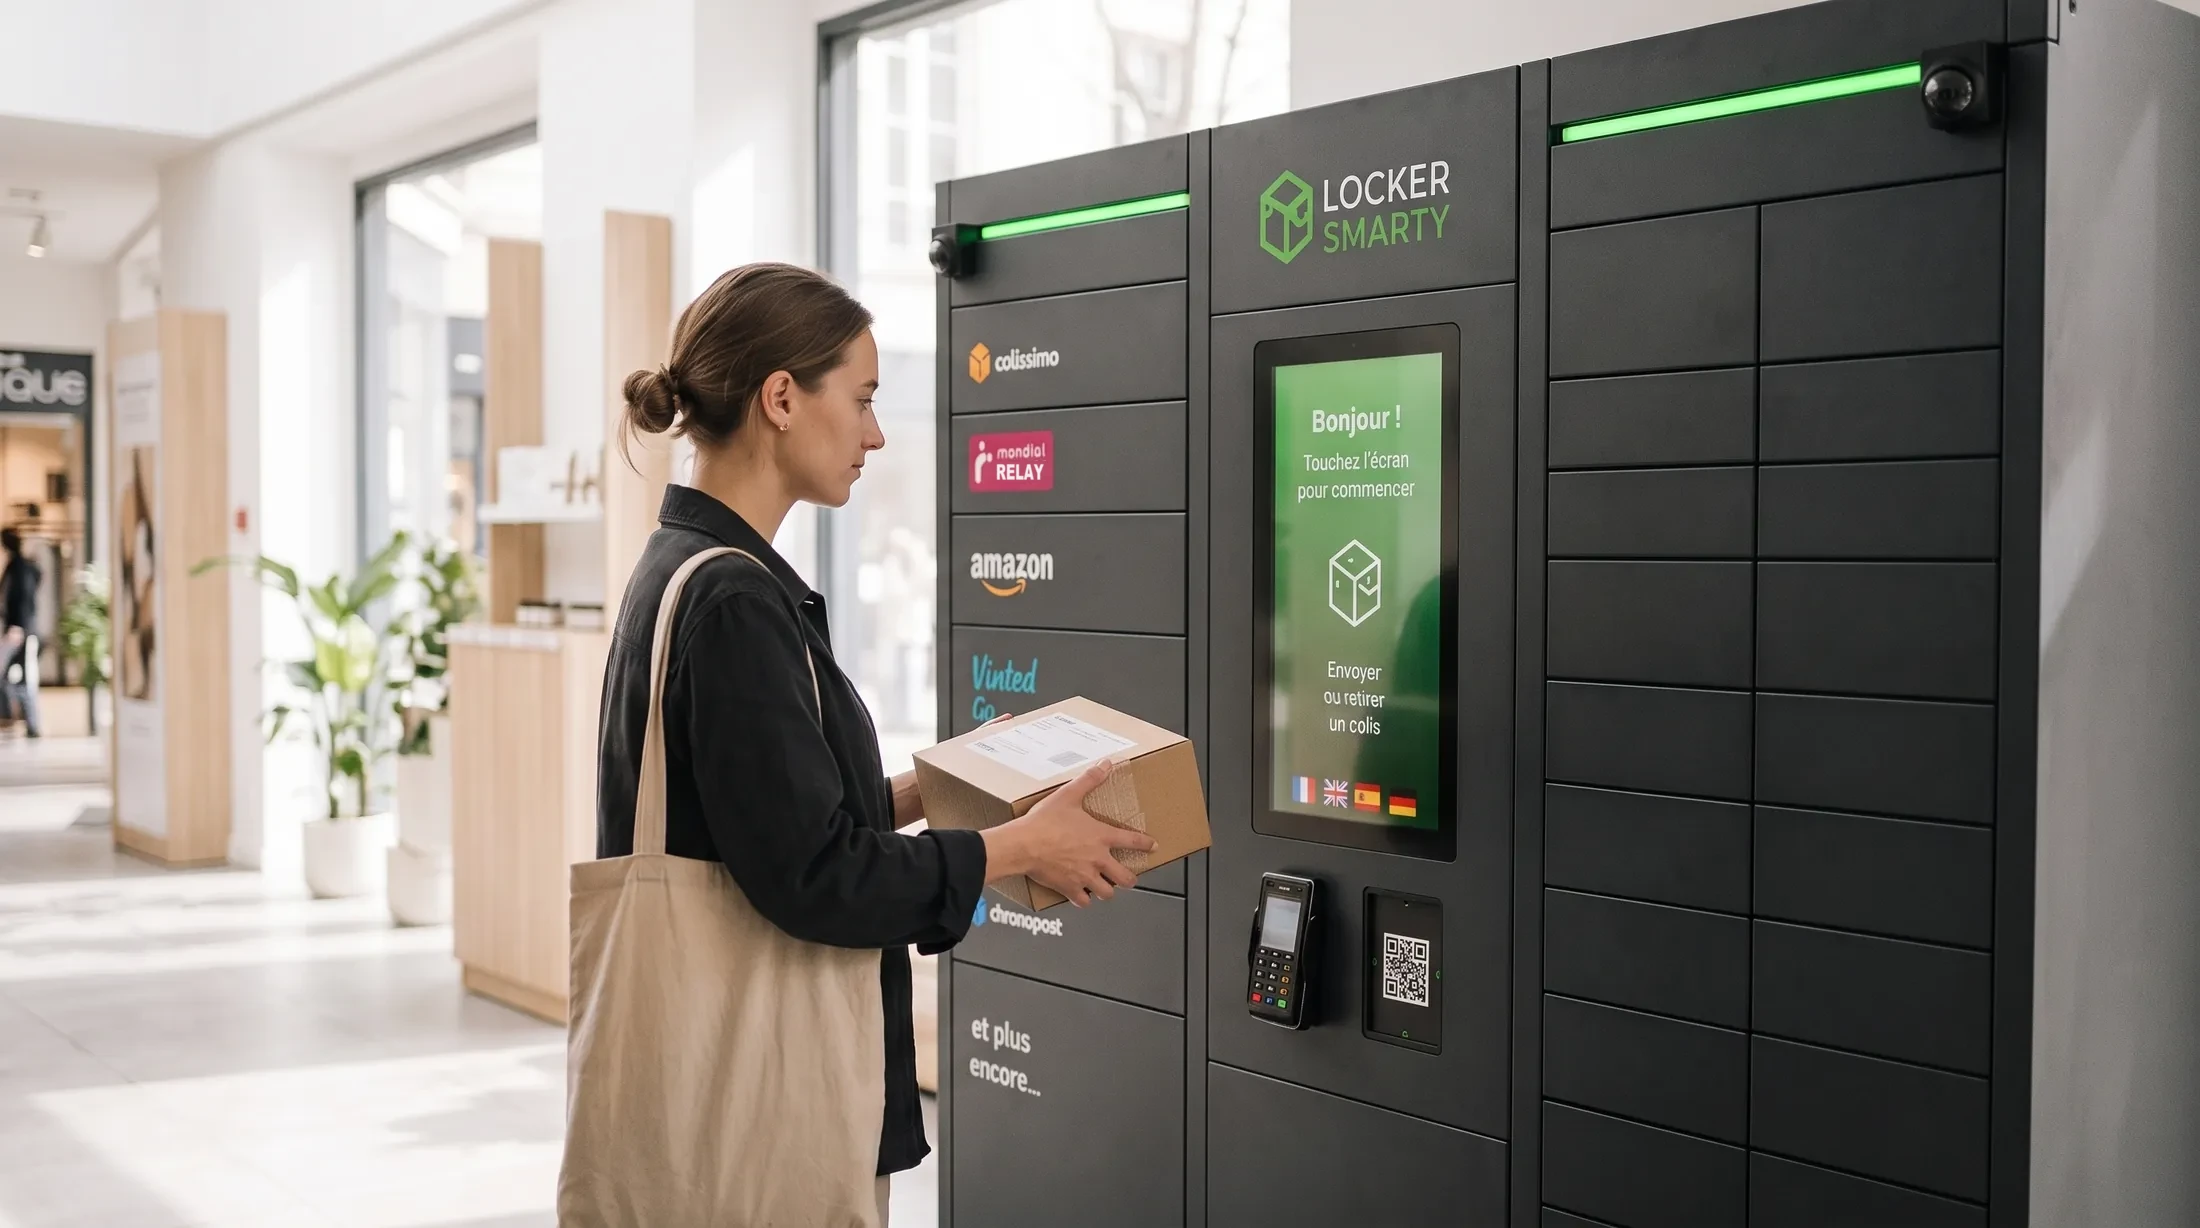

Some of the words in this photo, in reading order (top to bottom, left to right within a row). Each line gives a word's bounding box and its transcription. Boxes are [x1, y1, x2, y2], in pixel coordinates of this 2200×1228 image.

[1323, 160, 1450, 213] LOCKER
[1323, 204, 1450, 254] SMARTY
[994, 346, 1060, 372] colissimo
[1312, 406, 1390, 438] Bonjour
[1395, 404, 1401, 429] !
[997, 442, 1046, 460] mondial
[1303, 452, 1360, 471] Touchez
[1364, 450, 1409, 470] l'écran
[996, 463, 1044, 481] RELAY
[1297, 484, 1328, 503] pour
[1331, 482, 1415, 498] commencer
[970, 552, 1054, 580] amazon
[971, 653, 1038, 694] Vinted
[1327, 661, 1382, 684] Envoyer
[971, 695, 996, 721] Go
[1323, 690, 1341, 705] ou
[1344, 690, 1385, 708] retirer
[1329, 717, 1346, 732] un
[1349, 716, 1381, 735] colis
[989, 903, 1063, 936] chronopost
[971, 1017, 990, 1042] et
[993, 1021, 1032, 1053] plus
[969, 1056, 1041, 1097] encore...
